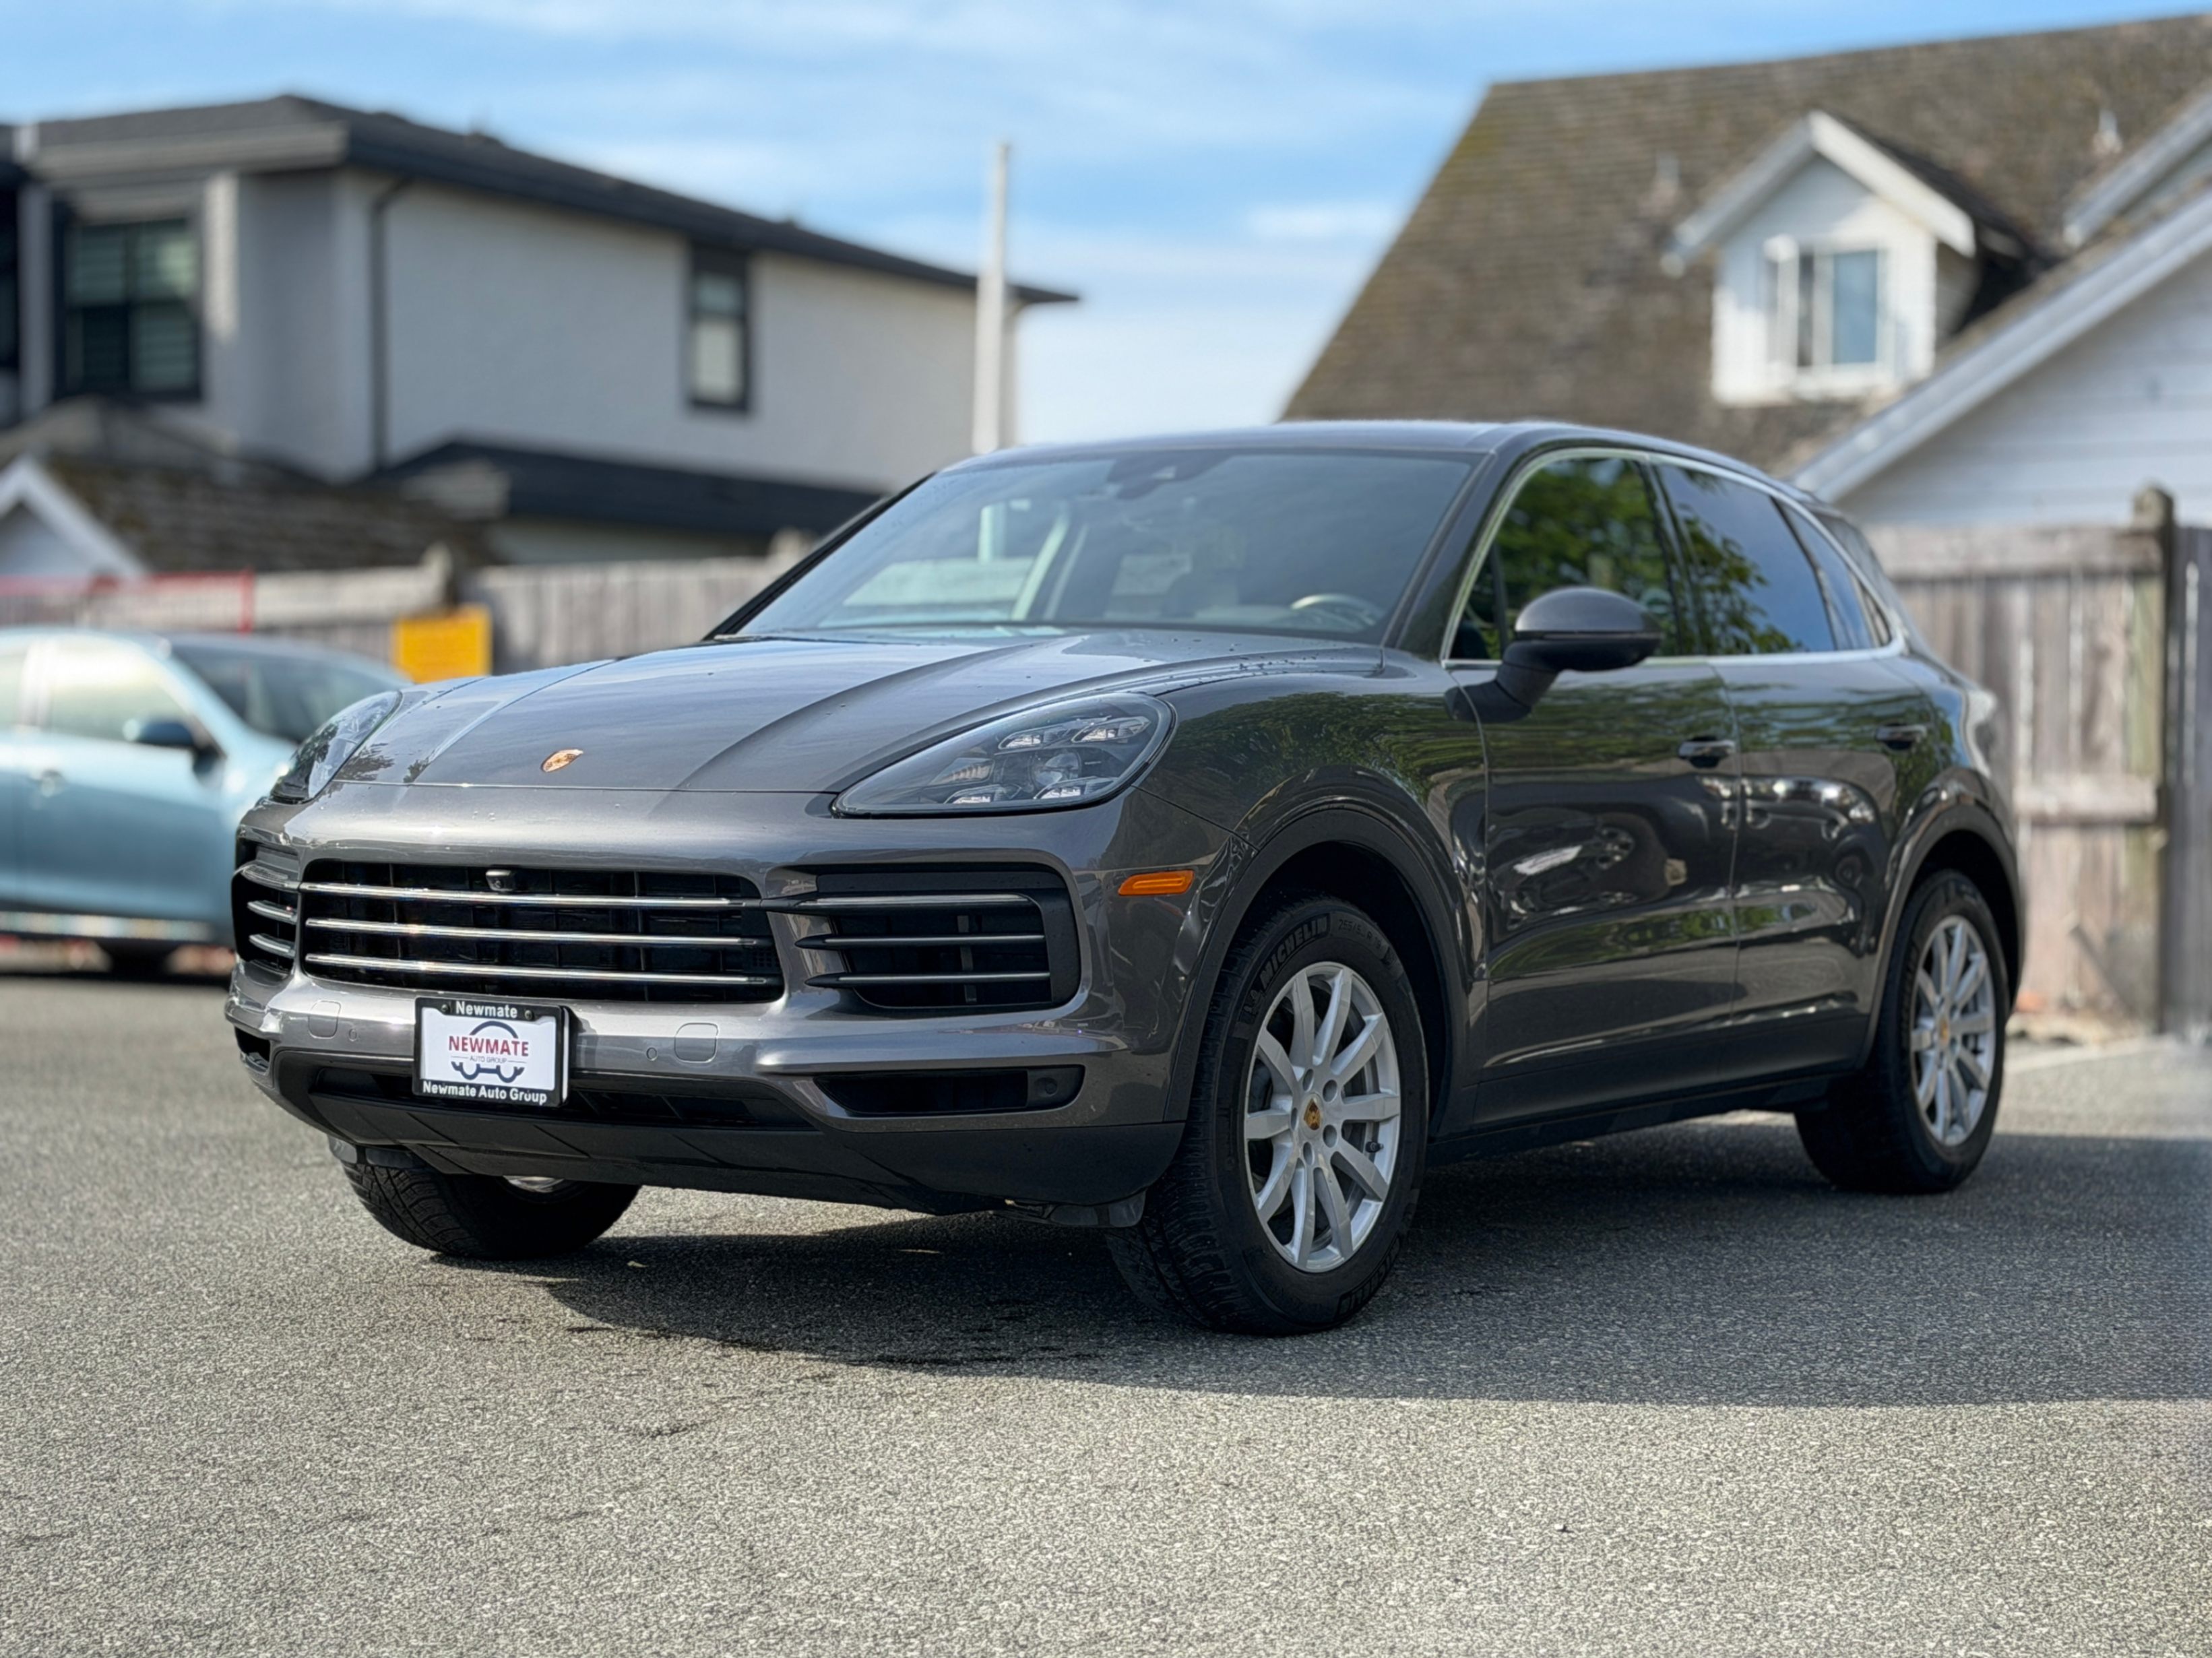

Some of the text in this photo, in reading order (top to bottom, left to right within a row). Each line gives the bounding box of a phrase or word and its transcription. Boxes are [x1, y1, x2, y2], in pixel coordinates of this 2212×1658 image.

[1261, 917, 1328, 990] MICHELIN
[455, 1001, 517, 1019] Newmate
[449, 1035, 529, 1056] NEWMATE
[422, 1081, 547, 1105] Newmate Auto Group
